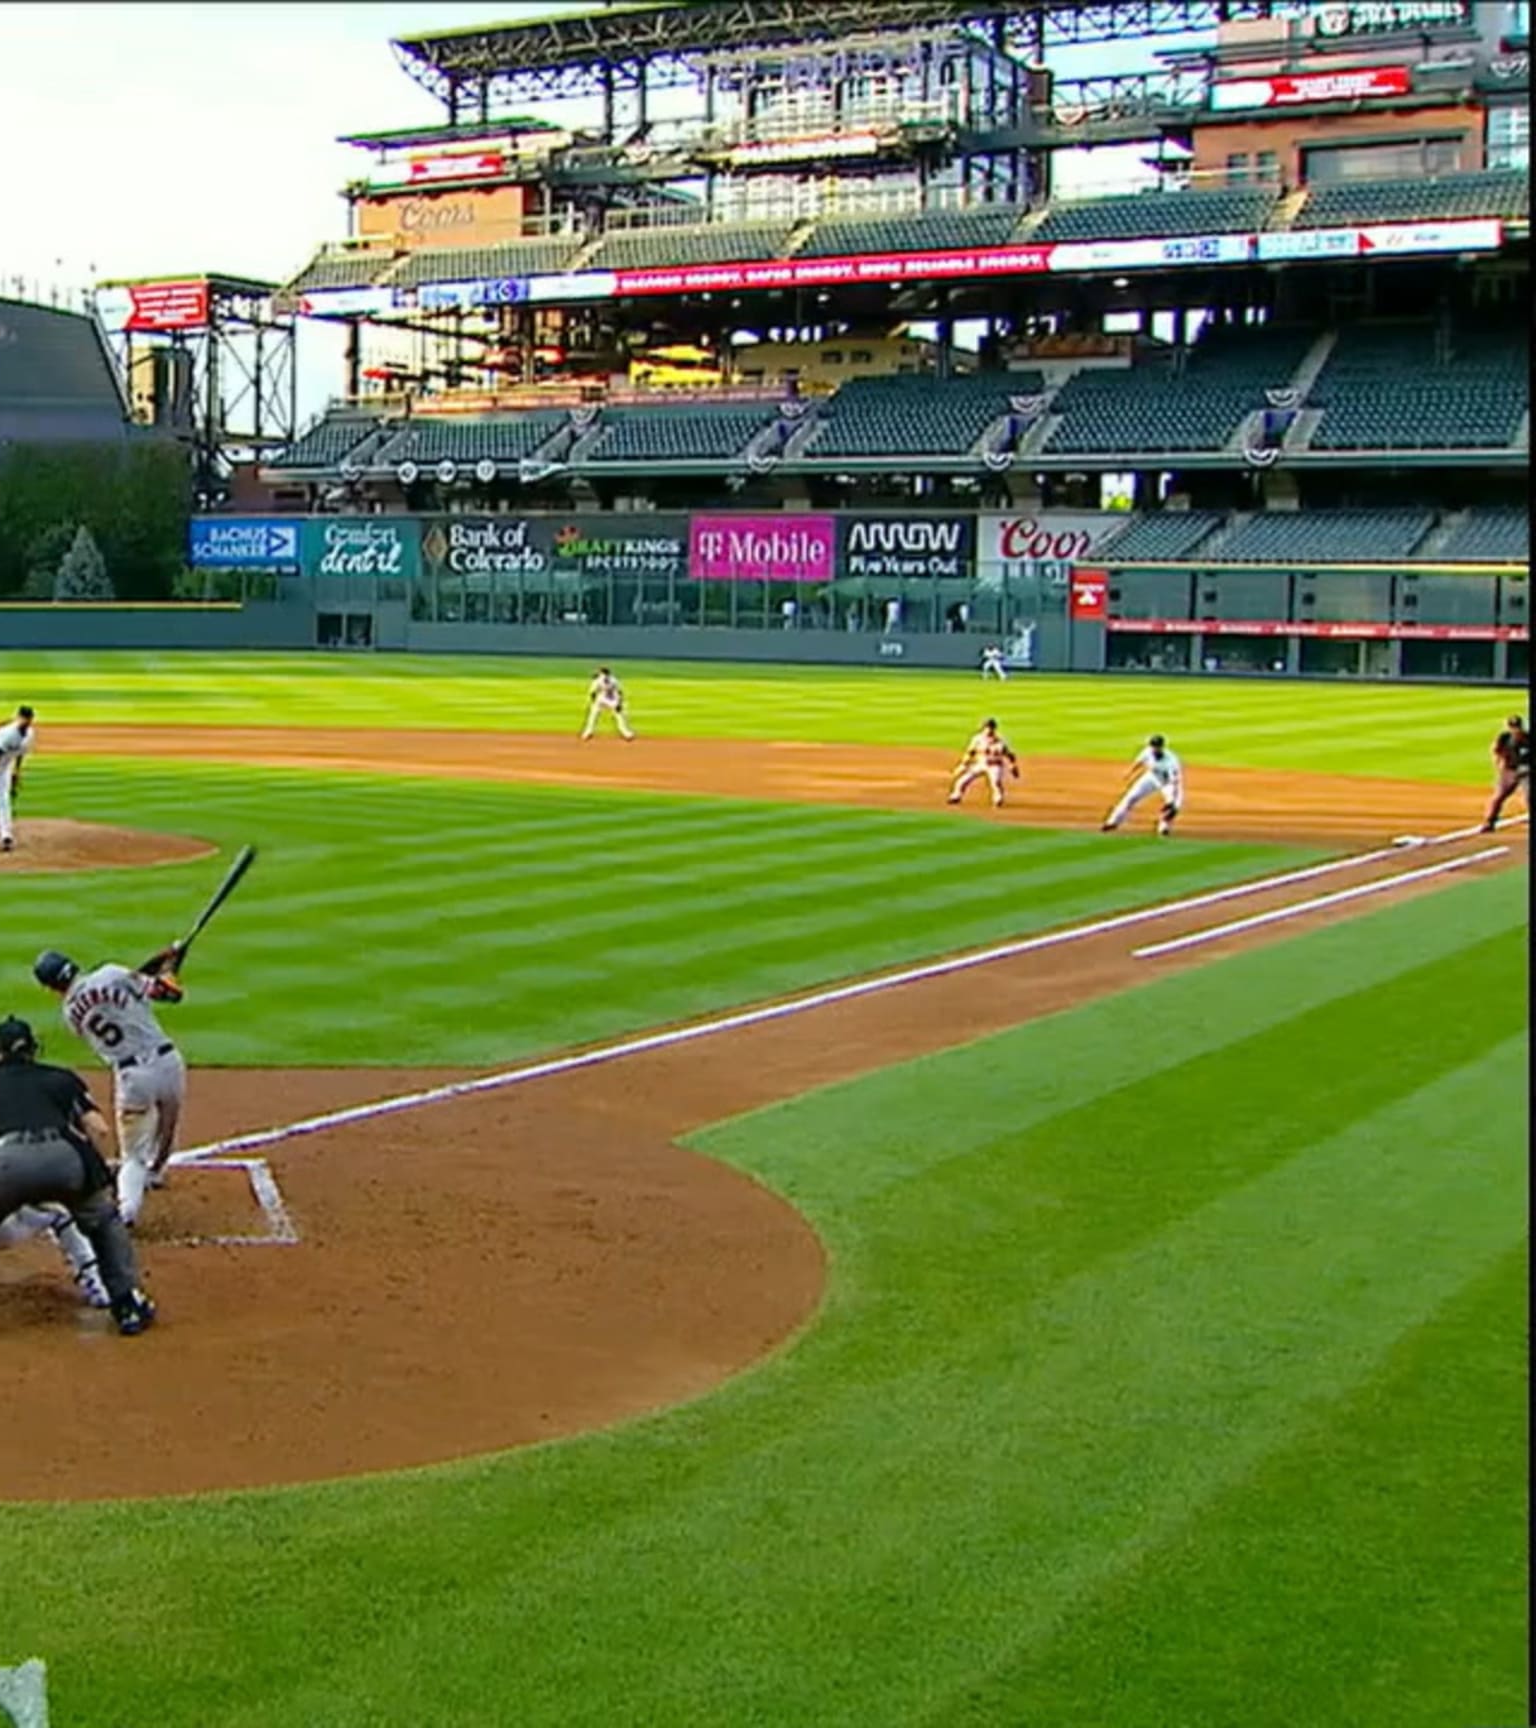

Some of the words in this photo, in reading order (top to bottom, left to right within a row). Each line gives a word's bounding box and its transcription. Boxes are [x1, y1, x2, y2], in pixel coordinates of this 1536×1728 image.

[450, 523, 500, 547] Bank
[503, 521, 526, 547] of
[728, 530, 826, 564] Mobile
[449, 546, 544, 572] Colorado
[87, 1012, 125, 1048] 5
